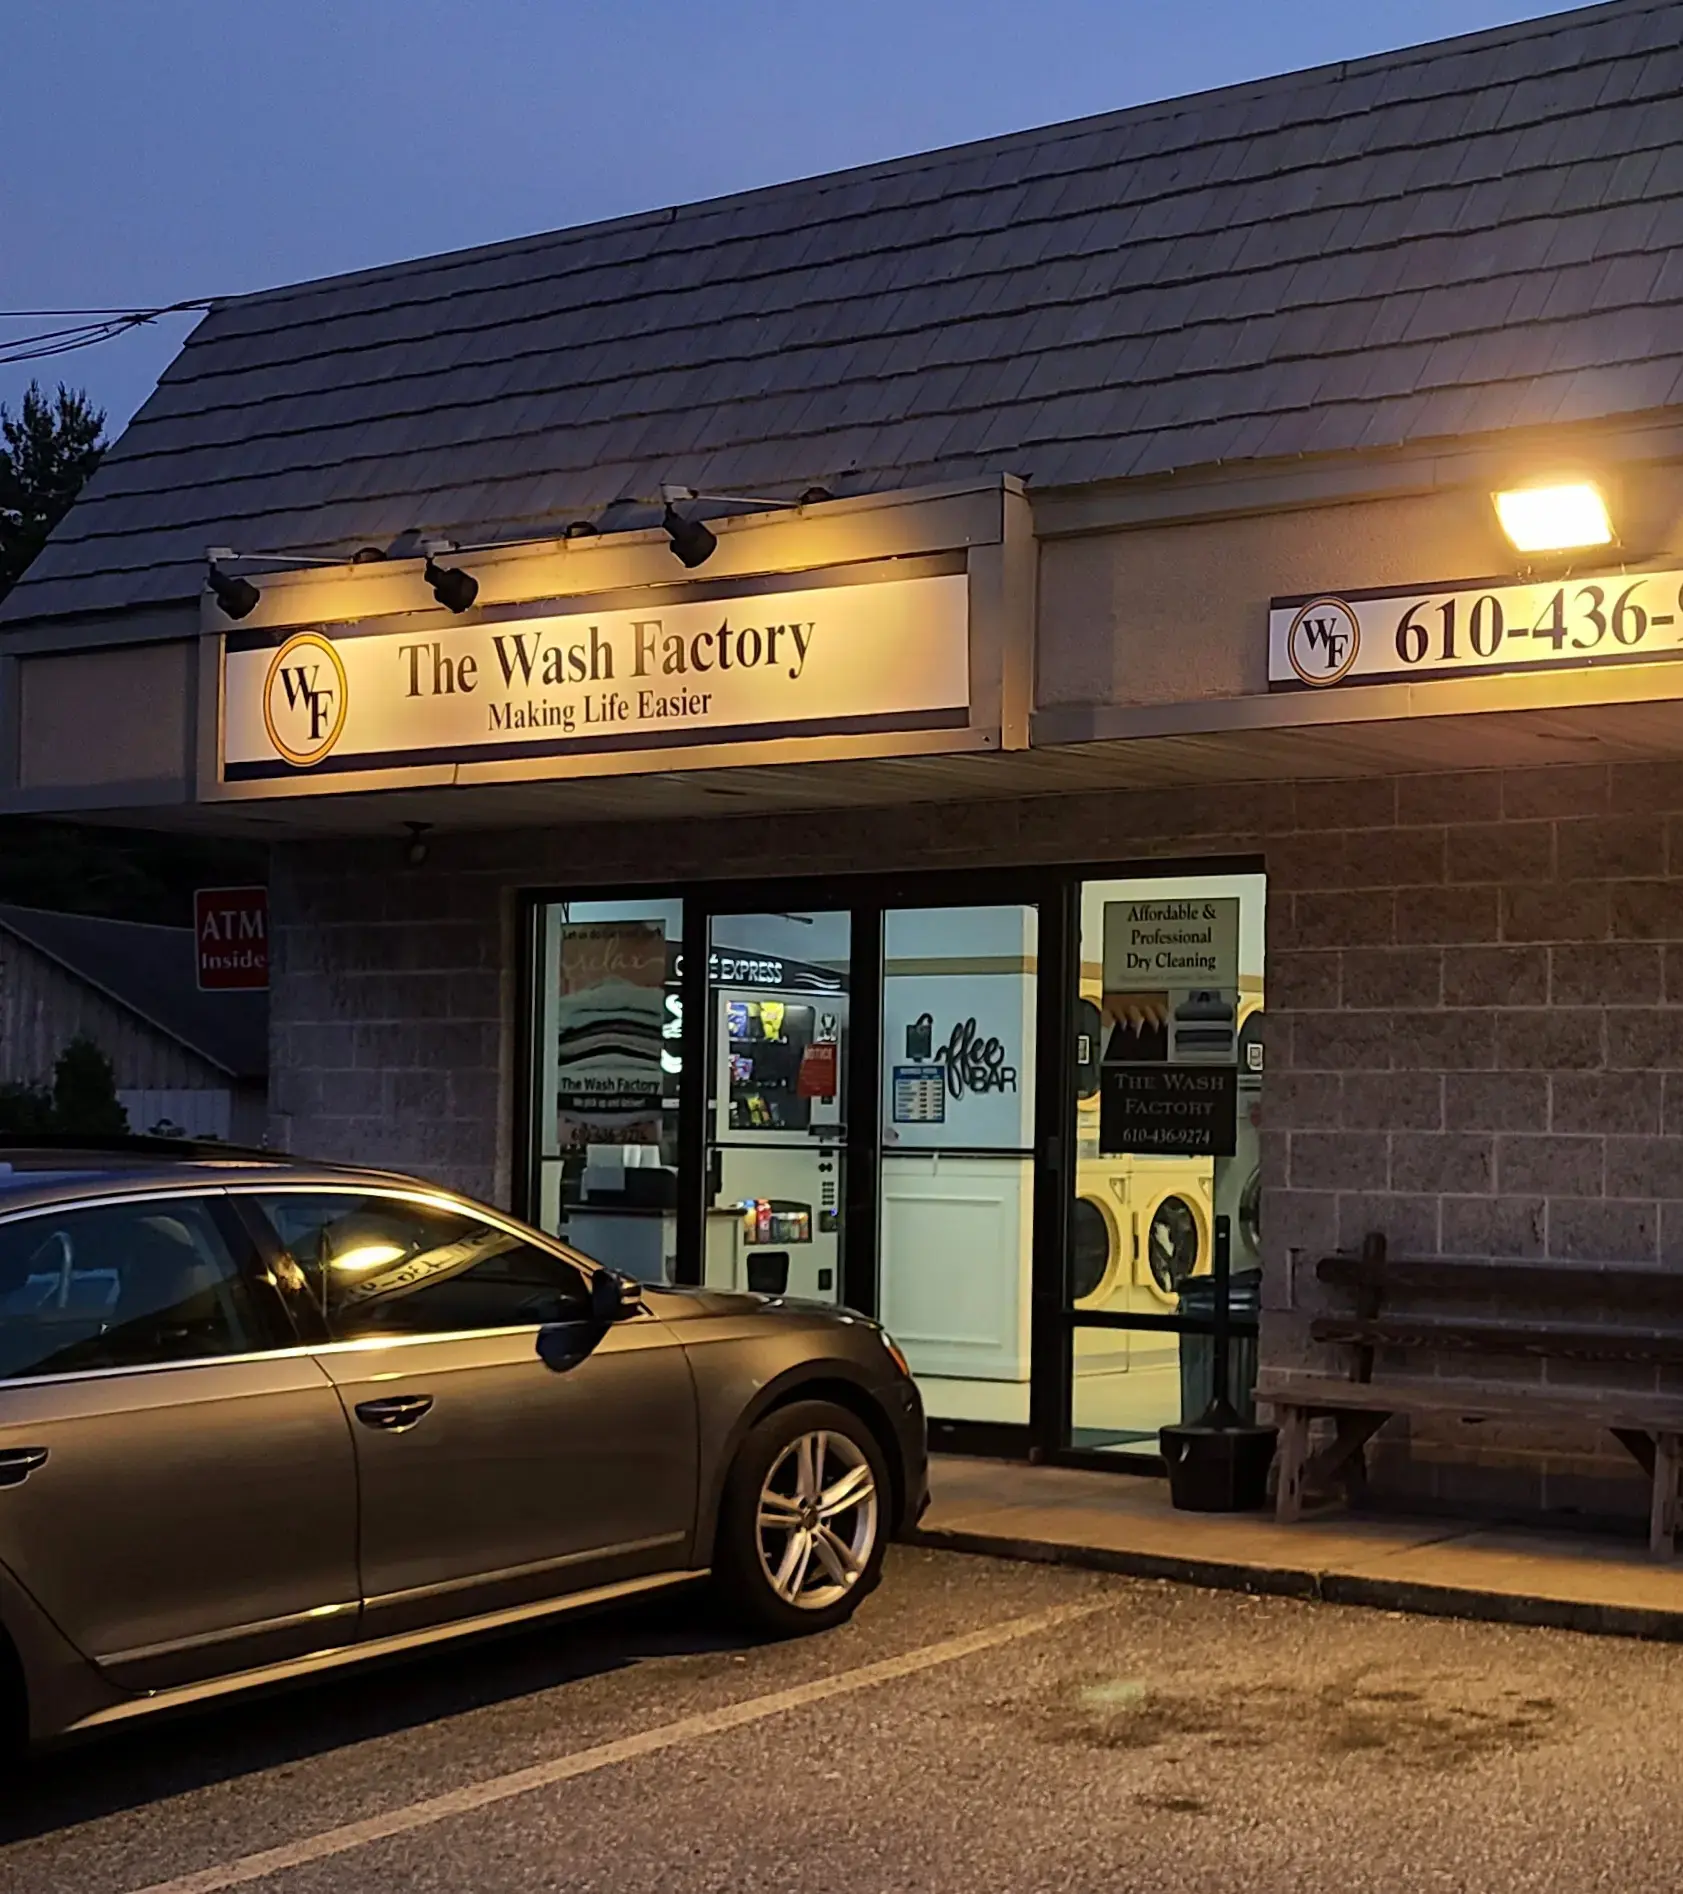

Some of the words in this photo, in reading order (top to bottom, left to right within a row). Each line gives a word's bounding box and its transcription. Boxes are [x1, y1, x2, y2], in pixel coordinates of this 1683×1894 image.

[399, 642, 478, 698] The
[491, 626, 615, 689] Wash
[630, 616, 816, 681] Factory
[488, 696, 576, 734] Making
[584, 691, 630, 725] Life
[637, 689, 713, 719] Easier
[1127, 902, 1199, 922] Affordable
[1202, 903, 1217, 920] &
[202, 910, 264, 940] ATM
[1131, 926, 1212, 945] Professional
[202, 949, 266, 970] Inside
[1126, 952, 1151, 972] Dry
[1155, 952, 1217, 971] Cleaning
[721, 959, 783, 983] EXPRESS
[561, 1077, 582, 1090] The
[584, 1077, 615, 1091] Wash
[618, 1077, 661, 1094] Factory
[970, 1067, 1017, 1093] BAR
[1123, 1128, 1211, 1145] 610-436-9274
